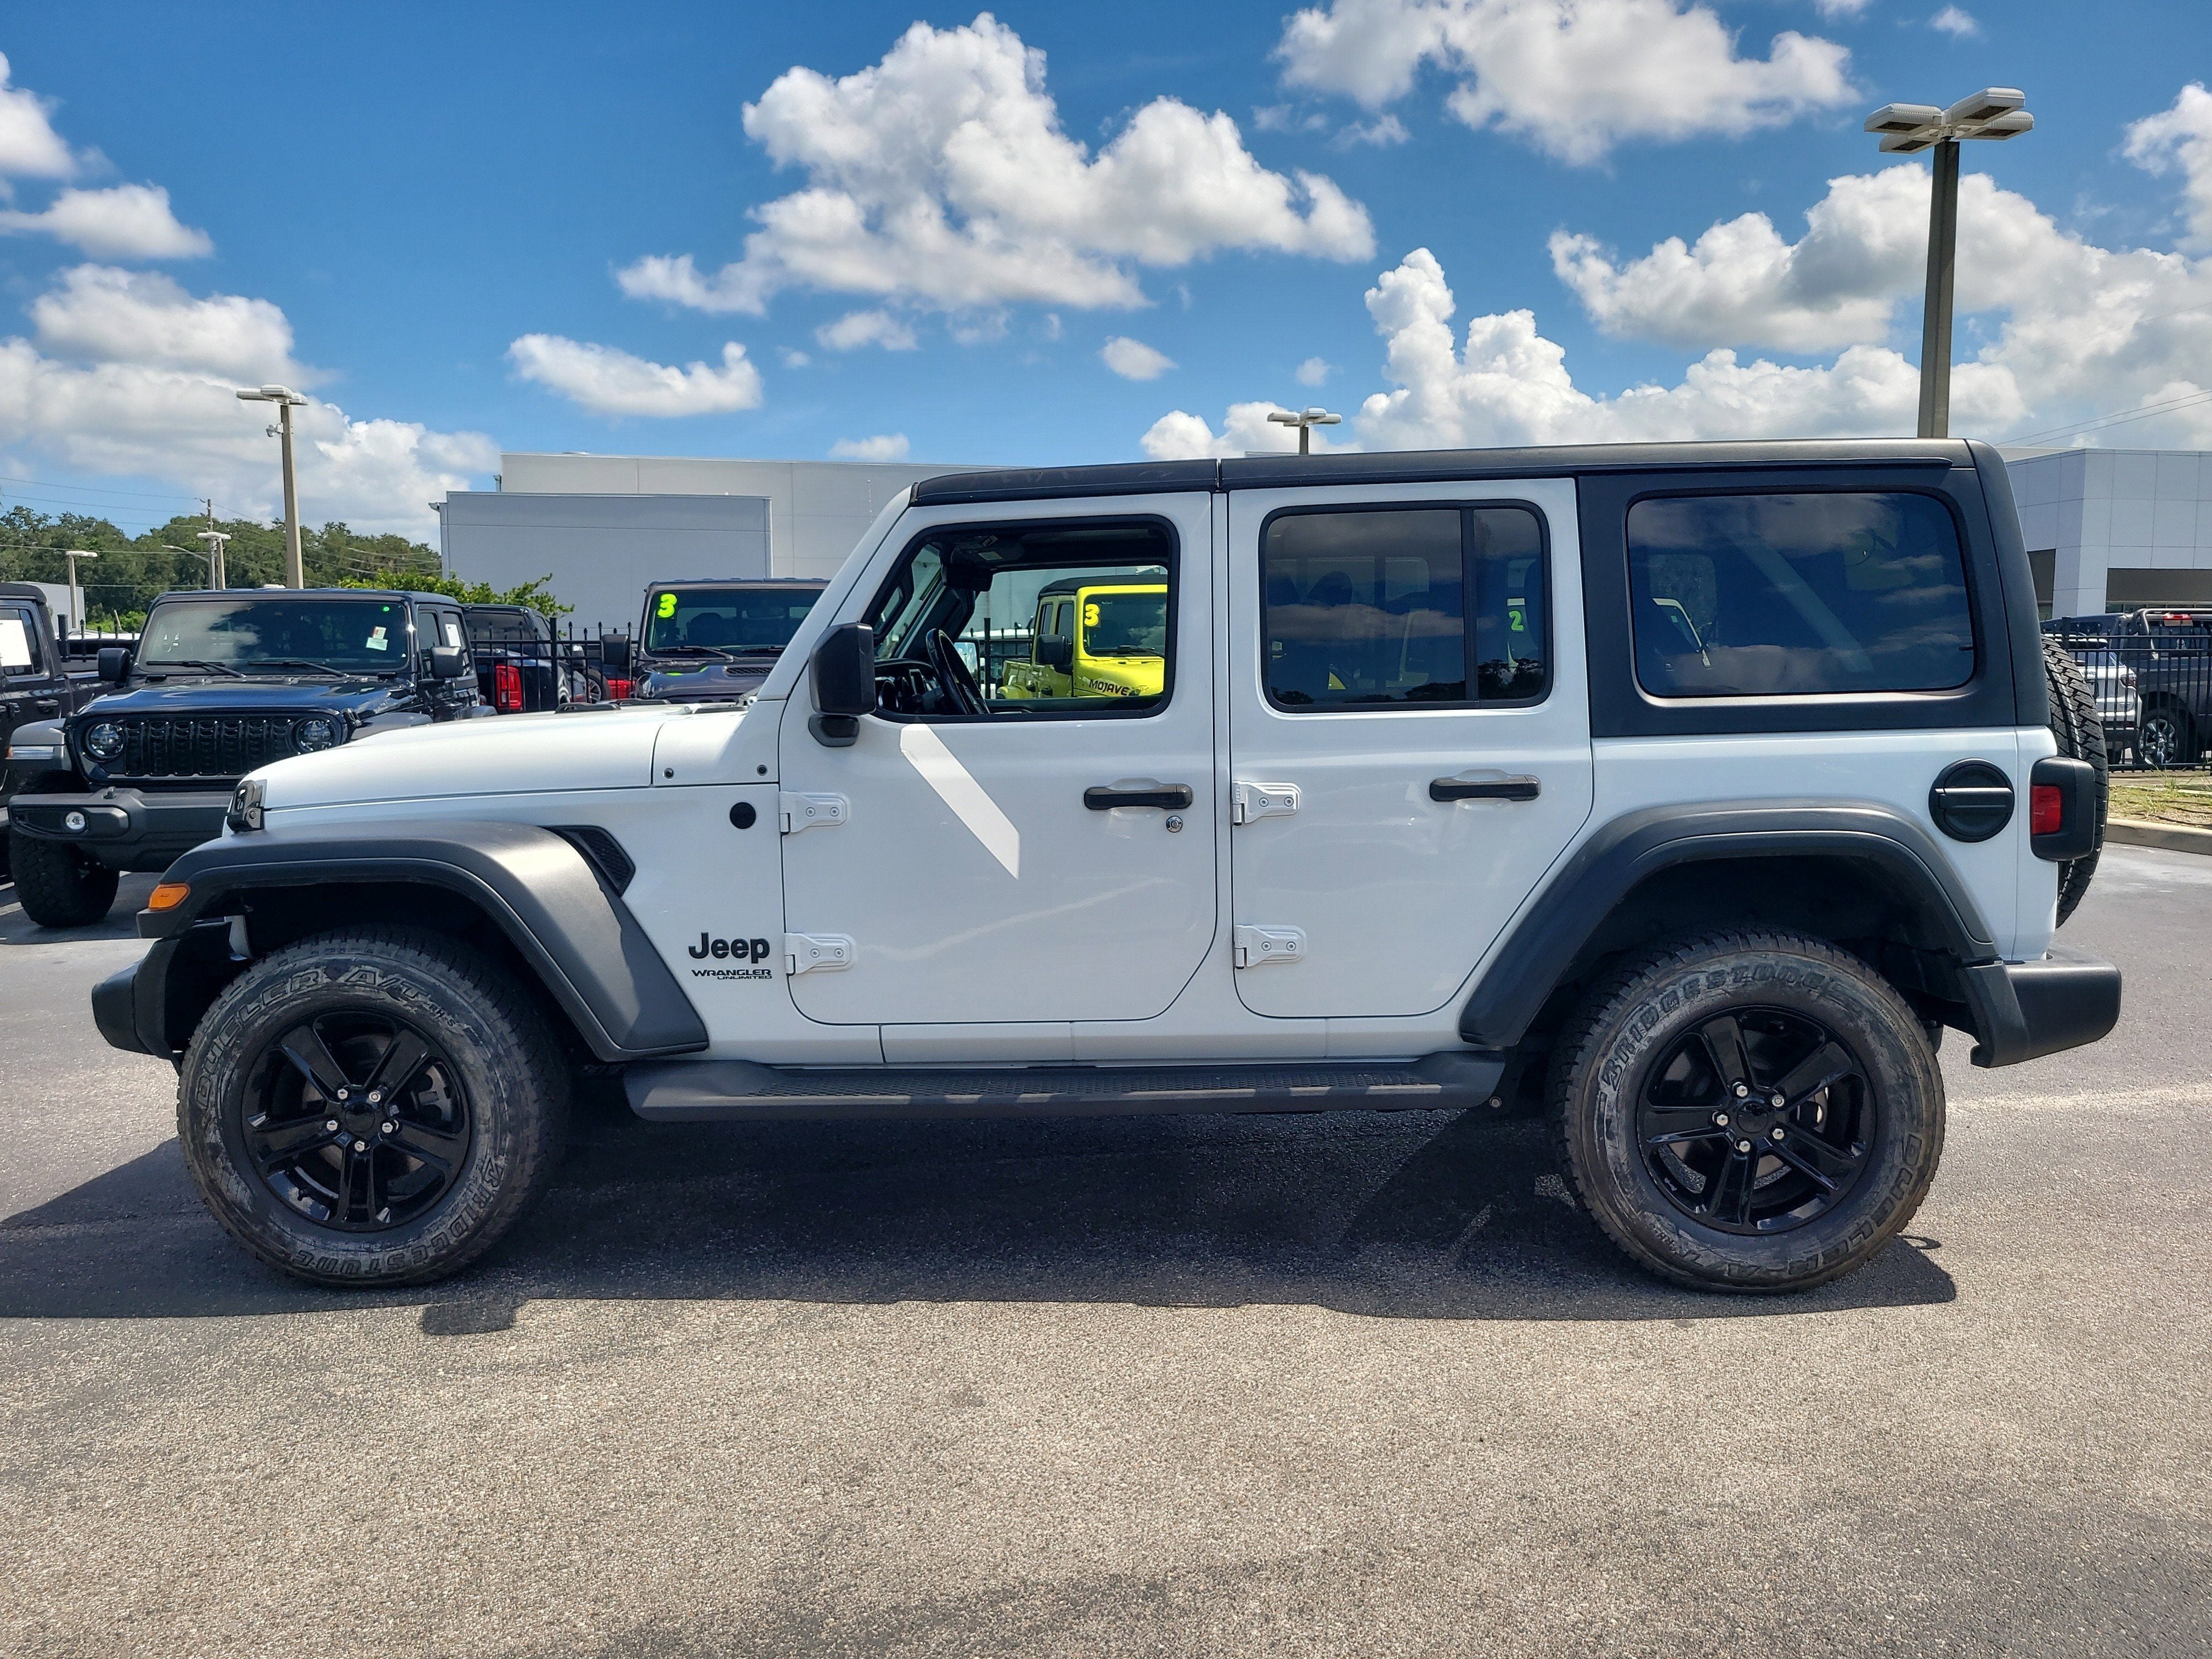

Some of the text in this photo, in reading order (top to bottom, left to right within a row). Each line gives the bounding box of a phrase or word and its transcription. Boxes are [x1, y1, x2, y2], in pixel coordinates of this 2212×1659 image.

[657, 594, 678, 618] 3
[1084, 603, 1100, 627] 3
[1509, 611, 1523, 631] 2
[1089, 679, 1130, 696] MOJAVE
[689, 932, 770, 963] Jeep
[195, 969, 323, 1109] DUELER
[345, 965, 427, 998] A/T
